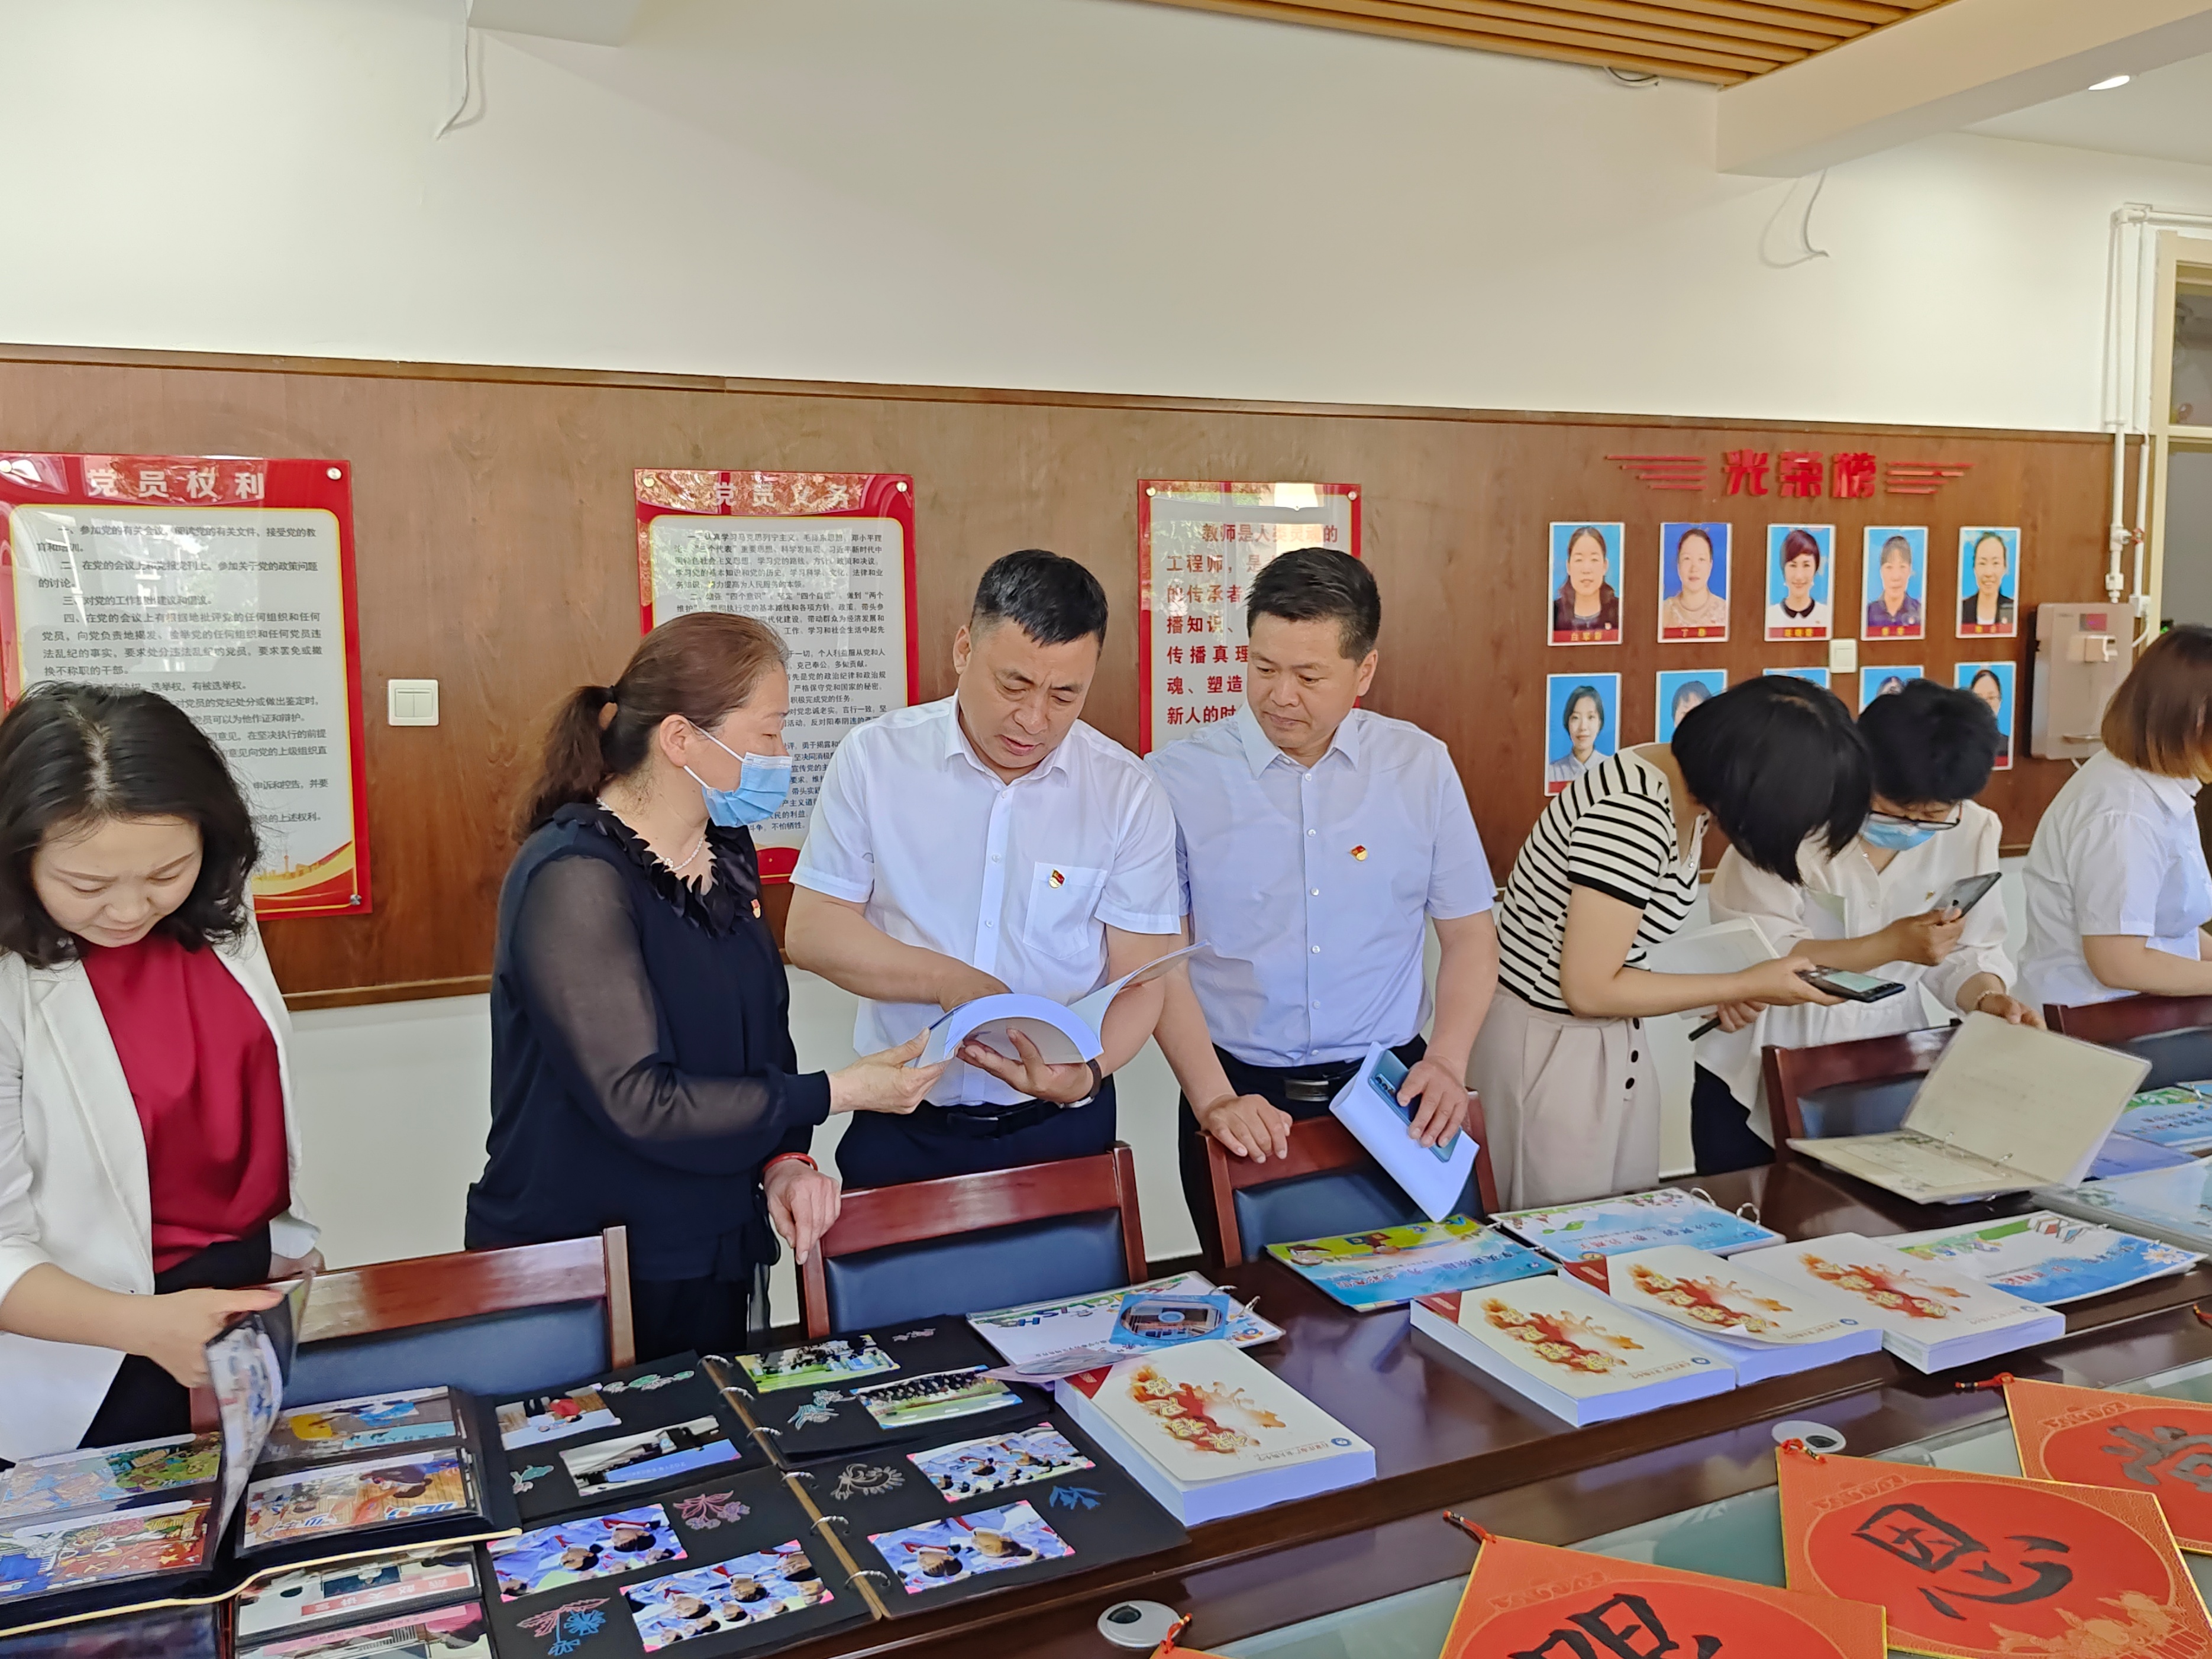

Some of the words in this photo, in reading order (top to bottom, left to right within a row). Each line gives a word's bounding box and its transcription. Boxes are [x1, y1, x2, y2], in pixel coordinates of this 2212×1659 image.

[1722, 449, 1877, 498] 光荣榜
[87, 469, 265, 500] 党员权利
[715, 482, 850, 508] 党员义务
[1202, 524, 1338, 543] 教师是人类灵魂的
[38, 578, 75, 588] 的讨论。
[1167, 584, 1242, 604] 的传承者
[1167, 615, 1234, 634] 播知识、
[1167, 645, 1249, 665] 传播真理
[44, 666, 129, 677] 换不称职的干部。
[1167, 676, 1243, 695] 魂、塑造
[790, 695, 854, 704] 积极完成党的任务。
[784, 740, 841, 750] 评，勇于揭露和
[1851, 1504, 2074, 1622] 恩
